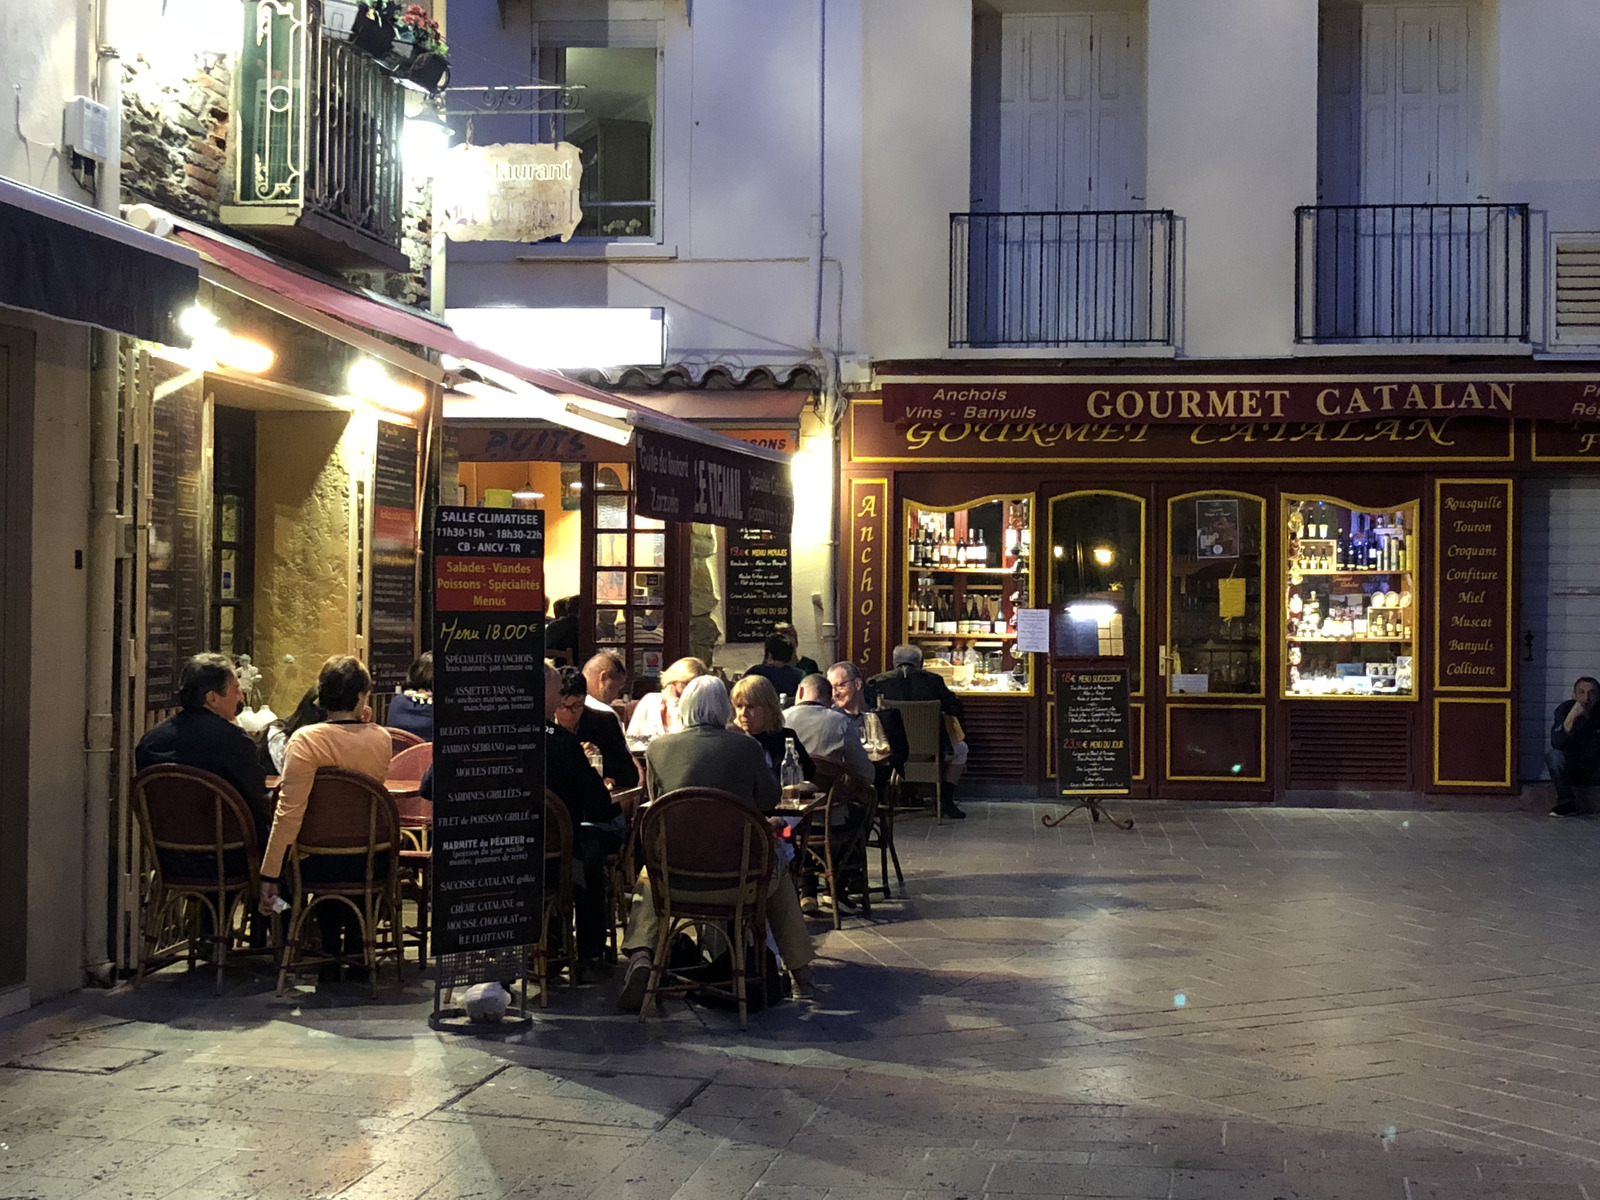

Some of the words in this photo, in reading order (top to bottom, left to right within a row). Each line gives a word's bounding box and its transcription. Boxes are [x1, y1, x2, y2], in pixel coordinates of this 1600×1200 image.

[495, 160, 573, 181] taurant
[933, 388, 1008, 401] Anchois
[1086, 390, 1290, 419] GOURMET
[1316, 383, 1515, 416] CATALAN
[905, 406, 943, 419] Vins
[963, 406, 1037, 422] Banyuls
[1445, 497, 1502, 512] Rousquille
[442, 512, 475, 523] SALLE
[478, 513, 538, 525] CLIMATISEE
[437, 527, 485, 537] 11h30-15h
[496, 529, 542, 539] 18h30-22h
[1454, 521, 1492, 532] Touron
[458, 542, 470, 551] CB
[477, 543, 504, 552] ANCV
[509, 543, 521, 552] TR
[1448, 545, 1497, 561] Croquant
[447, 561, 485, 573] Salades
[492, 563, 531, 574] Viandes
[857, 495, 878, 664] Anchois
[1447, 568, 1498, 583] Confiture
[437, 578, 481, 589] Poissons
[489, 579, 540, 591] Spécialités
[473, 596, 506, 606] Menus
[1458, 591, 1485, 603] Miel
[1451, 615, 1492, 627] Muscat
[440, 618, 479, 652] Menu
[1449, 640, 1494, 655] Banyuls
[1447, 662, 1496, 675] Collioure
[456, 686, 490, 696] ASSIETTE
[492, 686, 515, 695] TAPAS
[440, 727, 470, 736] BULOTS
[473, 725, 516, 734] CREVETTES
[472, 742, 504, 752] SERRANO
[456, 767, 486, 777] MOULES
[488, 765, 514, 775] FRITES
[447, 789, 485, 801] SARDINES
[438, 817, 460, 827] FILET
[461, 816, 469, 825] de
[470, 814, 503, 824] POISSON
[443, 839, 478, 850] MARMITE
[440, 880, 477, 891] SAUCISSE
[478, 875, 516, 887] CATALANE
[477, 899, 515, 913] CATALANE
[447, 919, 478, 931] MOUSSE
[479, 914, 519, 928] CHOCOLAT
[472, 930, 515, 943] FLOTTANTE
